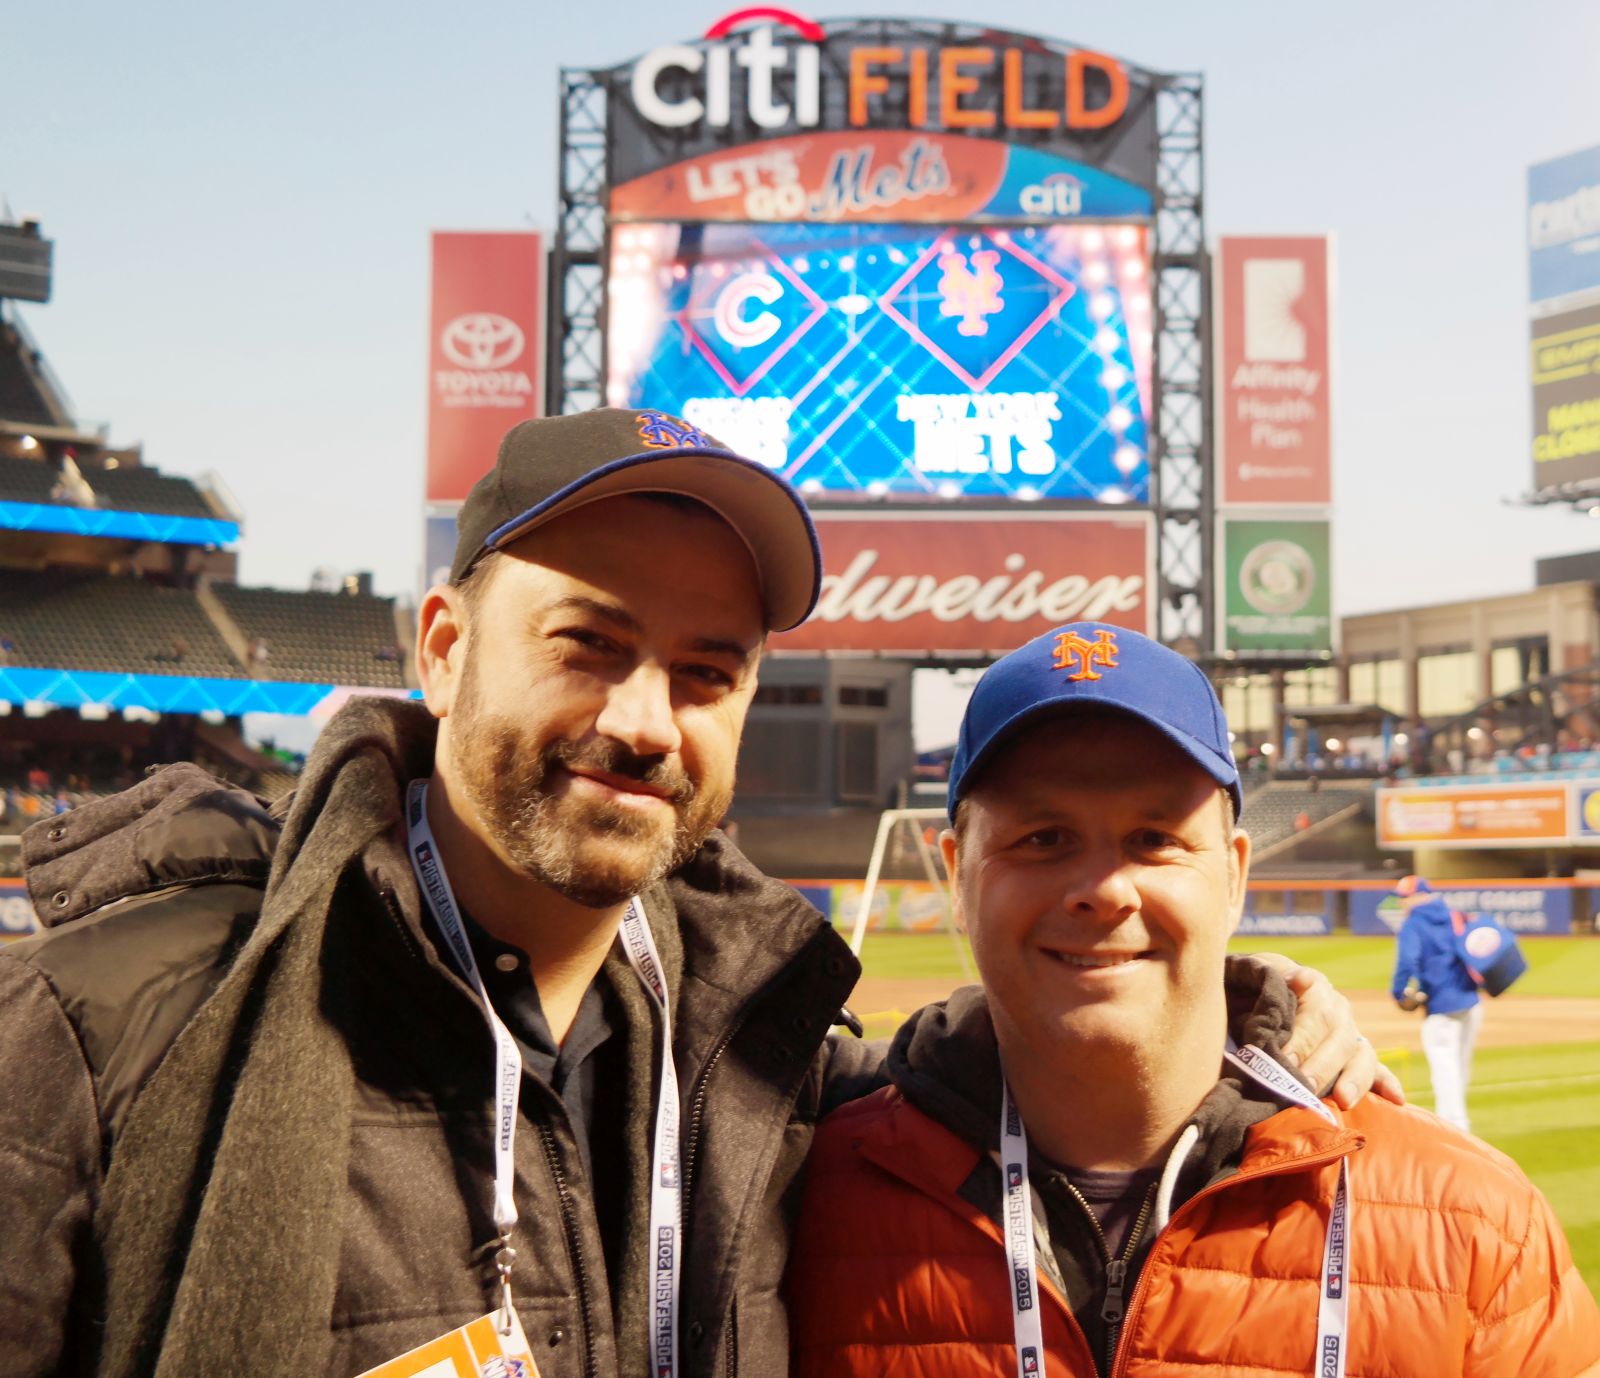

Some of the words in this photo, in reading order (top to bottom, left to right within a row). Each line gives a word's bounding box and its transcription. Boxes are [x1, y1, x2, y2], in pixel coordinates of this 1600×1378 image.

[632, 27, 820, 128] citi
[848, 47, 1130, 129] FIELD
[804, 138, 950, 219] Mets
[1019, 180, 1082, 215] citi
[745, 183, 806, 220] GO
[435, 371, 532, 396] TOYOTA
[1232, 364, 1321, 396] Affinity
[1237, 396, 1315, 422] Health
[914, 420, 1056, 475] METS
[1251, 421, 1303, 449] Plan
[806, 550, 1143, 621] dweiser
[421, 856, 459, 938] POSTSEASON
[625, 917, 660, 987] POSTSEASON
[1236, 1047, 1253, 1062] 20
[658, 1227, 673, 1268] 2015
[1009, 1185, 1028, 1269] POSTSEASON
[1328, 1191, 1345, 1275] POSTSEASON
[1015, 1270, 1032, 1309] 2015
[657, 1269, 673, 1366] POSTSEASON
[1323, 1337, 1338, 1377] 2015
